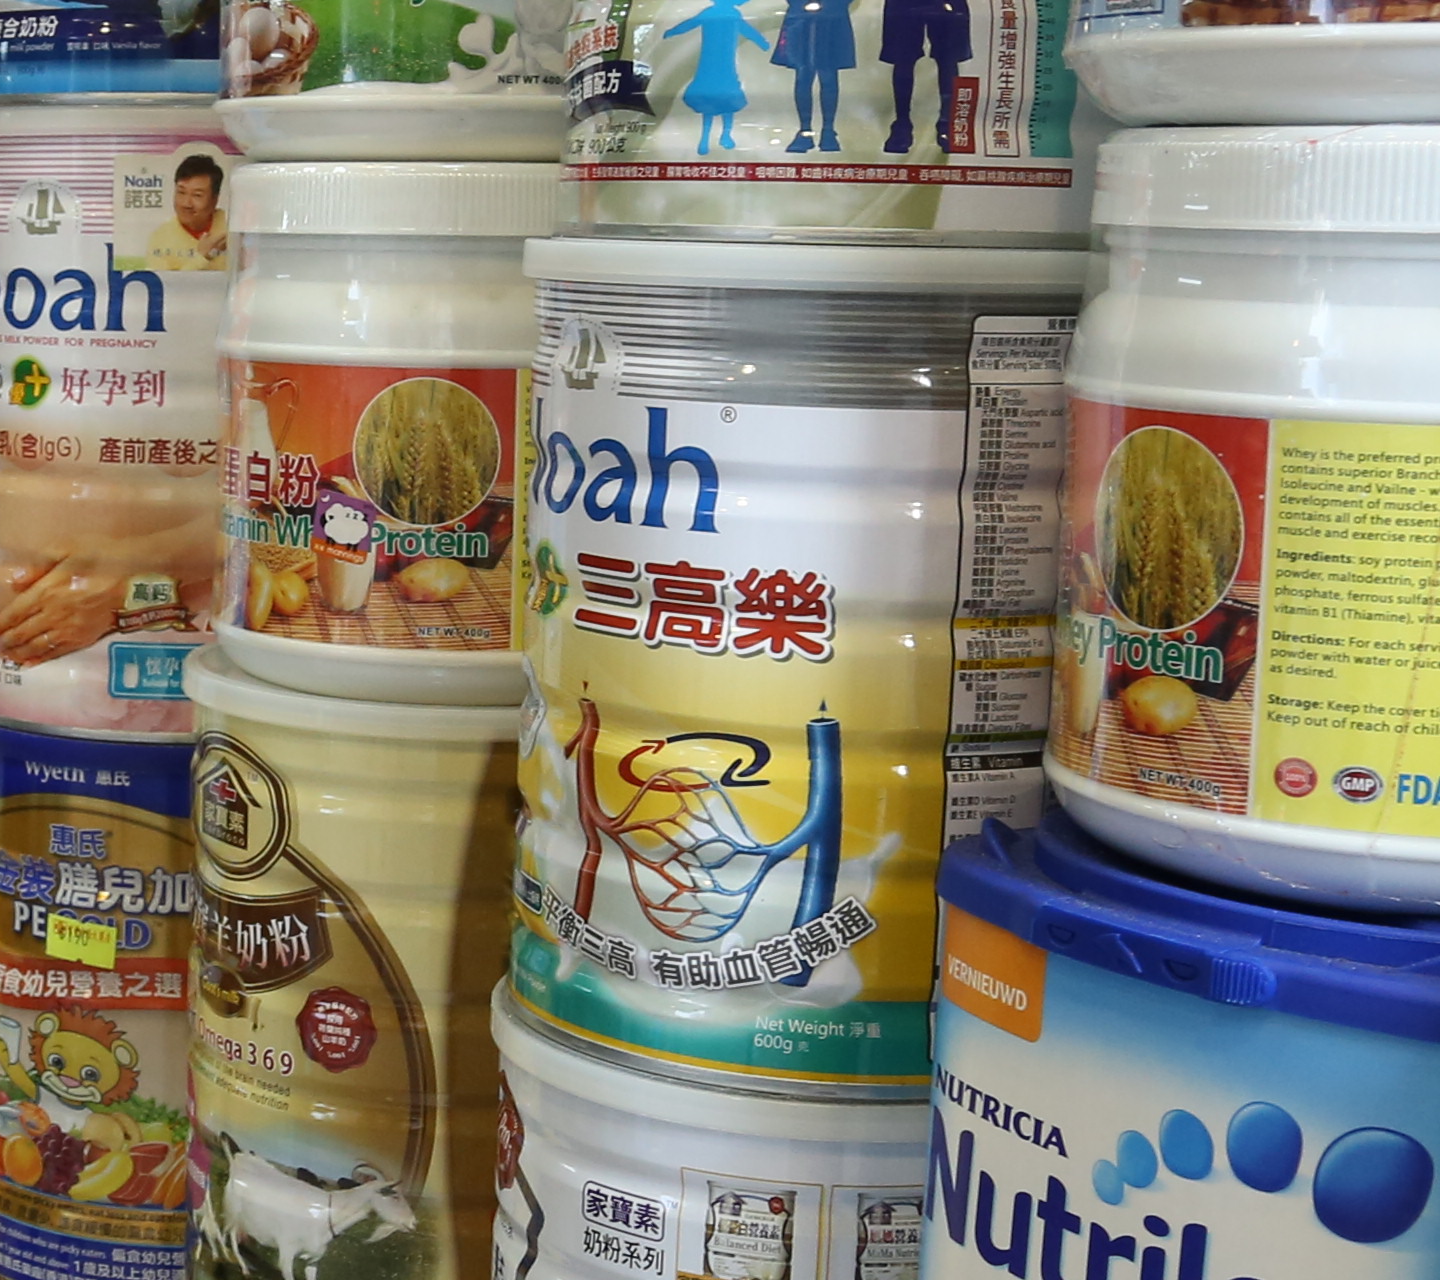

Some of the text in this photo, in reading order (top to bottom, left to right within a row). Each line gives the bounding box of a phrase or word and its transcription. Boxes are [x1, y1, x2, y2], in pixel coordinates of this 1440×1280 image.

[124, 173, 163, 189] Noah
[370, 521, 488, 559] Protein
[574, 551, 835, 661] 三高樂
[1097, 615, 1223, 685] Protein
[1271, 630, 1345, 649] Directions:
[1268, 693, 1324, 712] Storage:
[1341, 775, 1375, 794] GMP
[50, 824, 107, 859] 惠氏
[541, 887, 878, 992] 平衡三高 有助血管暢通
[946, 951, 1029, 1014] VERNIEUWD
[753, 1033, 794, 1055] 600g
[755, 1014, 881, 1040] Net Weight 淨重
[934, 1061, 1070, 1160] NUTRICIA
[586, 1188, 661, 1235] 家寶素
[583, 1227, 664, 1276] 奶粉系列
